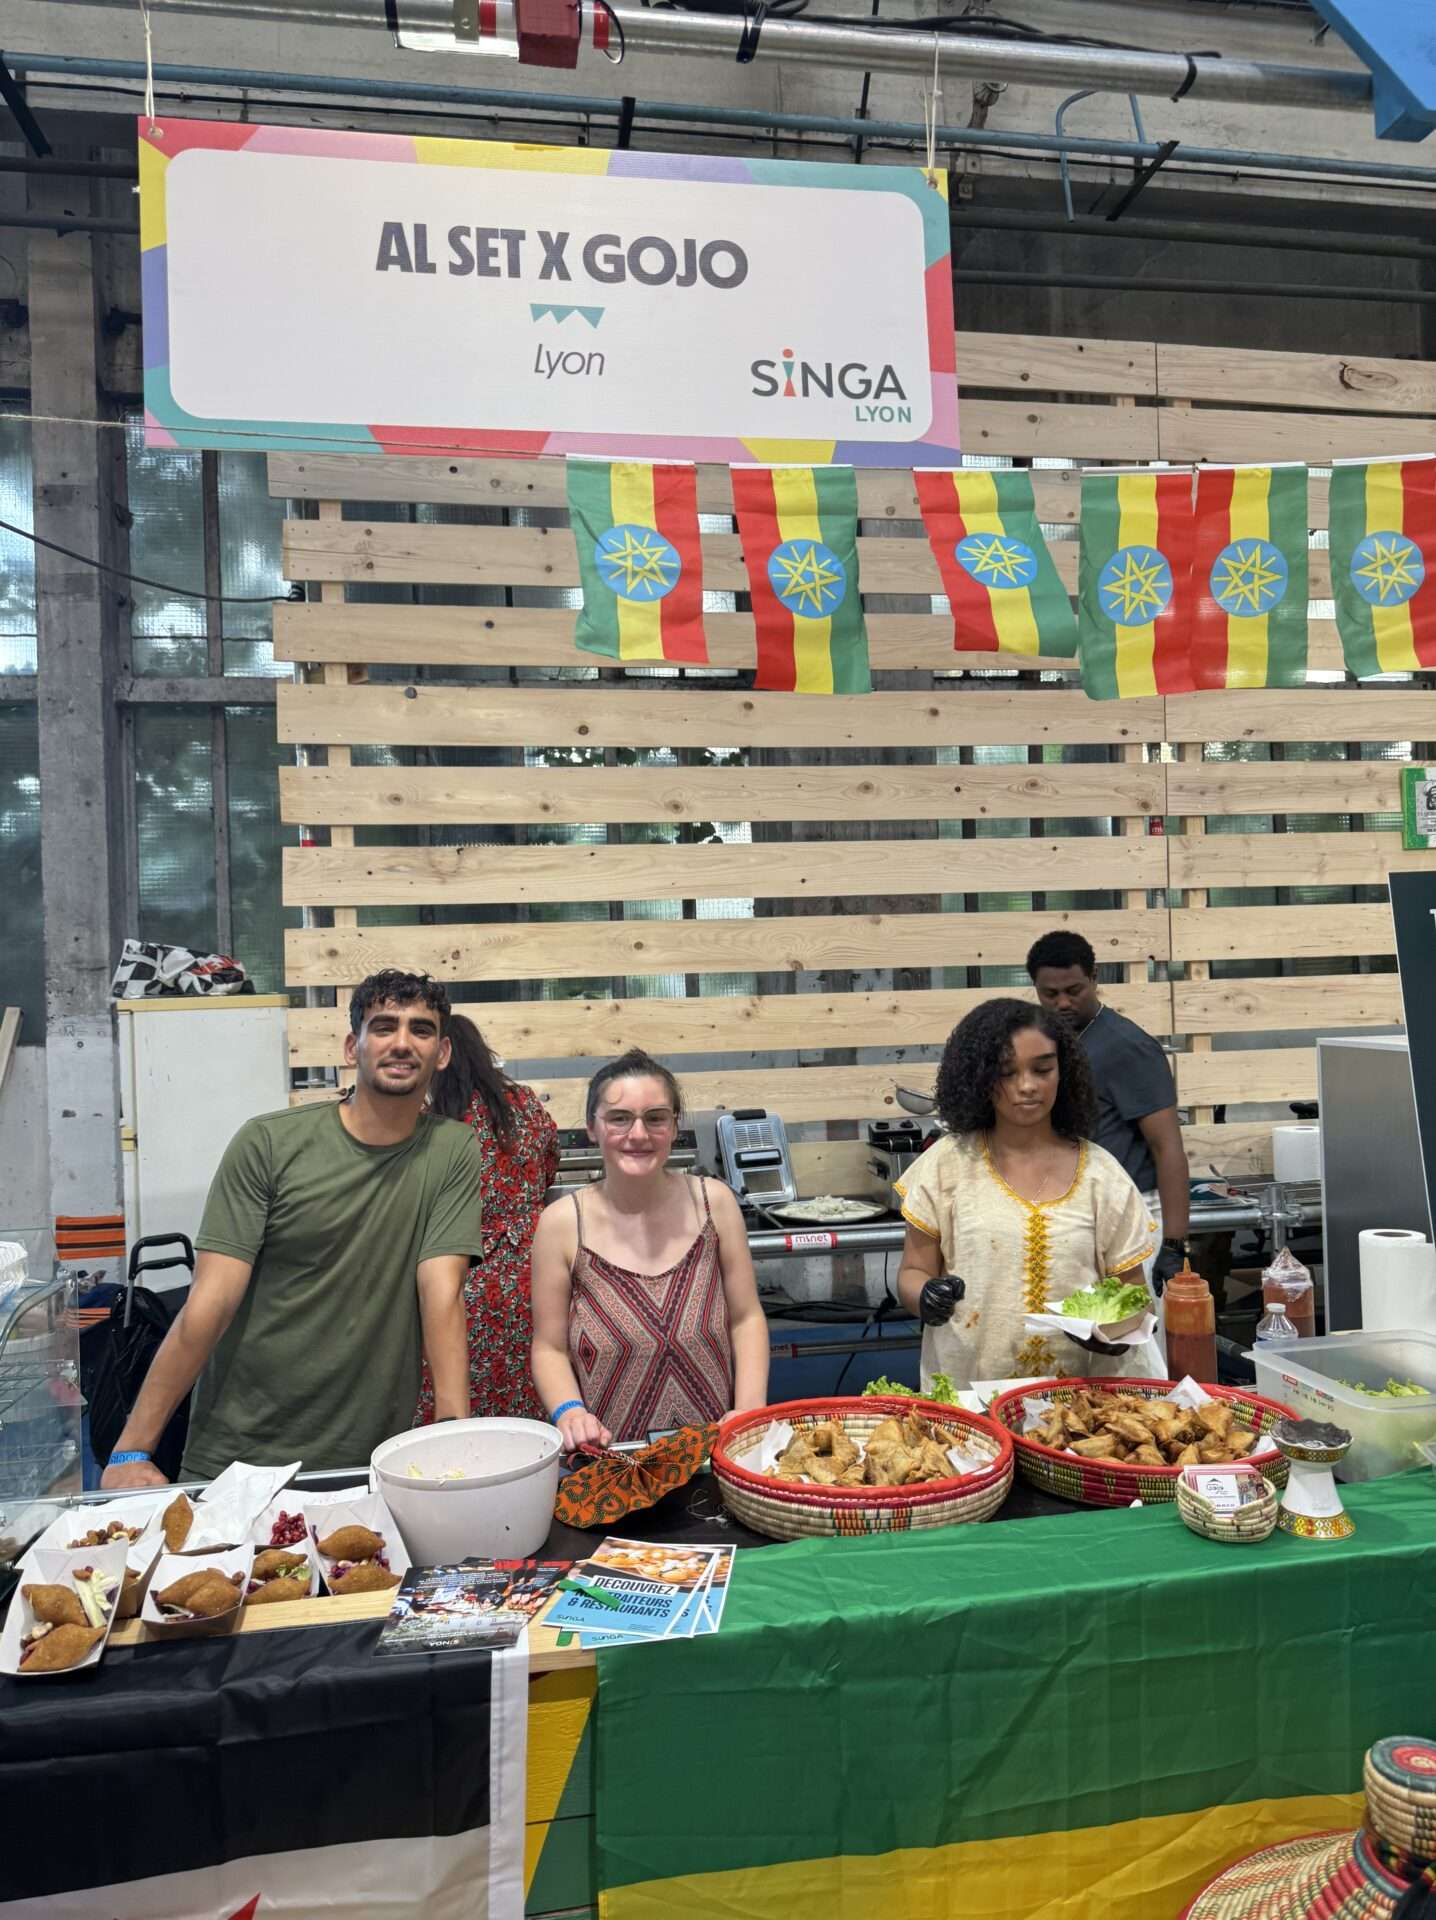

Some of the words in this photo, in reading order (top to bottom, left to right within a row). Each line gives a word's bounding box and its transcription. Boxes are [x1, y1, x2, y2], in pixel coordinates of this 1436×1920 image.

[376, 221, 436, 274] AL
[447, 225, 526, 278] SET
[536, 230, 572, 281] X
[582, 233, 748, 289] GOJO
[534, 343, 605, 380] Lyon
[855, 405, 912, 423] LYON
[567, 1597, 579, 1607] &
